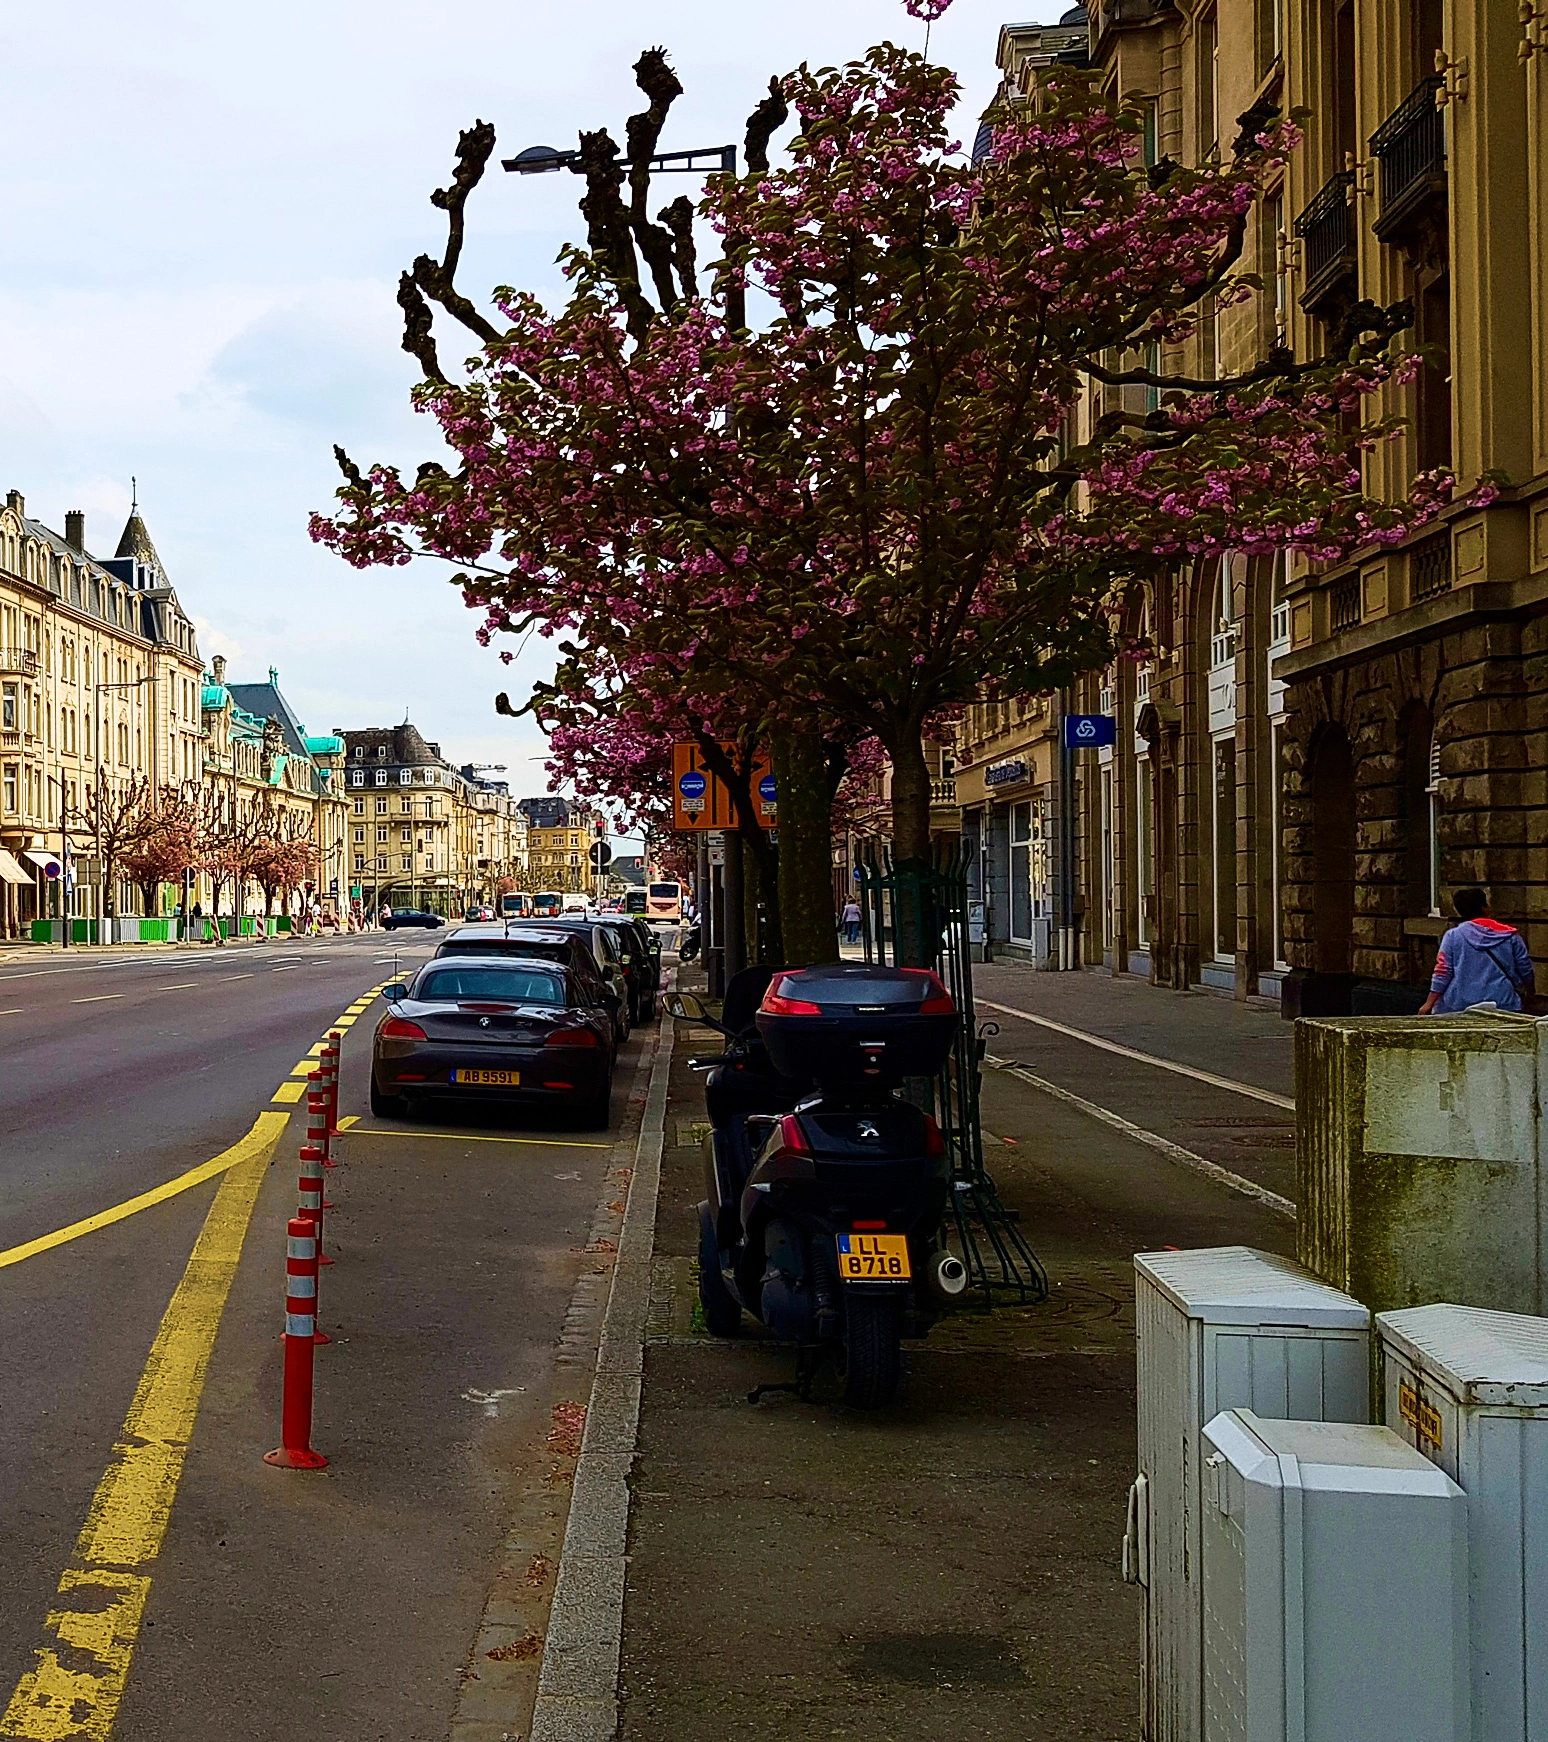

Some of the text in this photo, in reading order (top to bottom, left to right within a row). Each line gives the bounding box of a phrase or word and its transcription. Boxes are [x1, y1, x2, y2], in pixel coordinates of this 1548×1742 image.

[464, 1070, 513, 1084] AB 9591
[858, 1237, 887, 1255] LL
[848, 1256, 902, 1275] 8718
